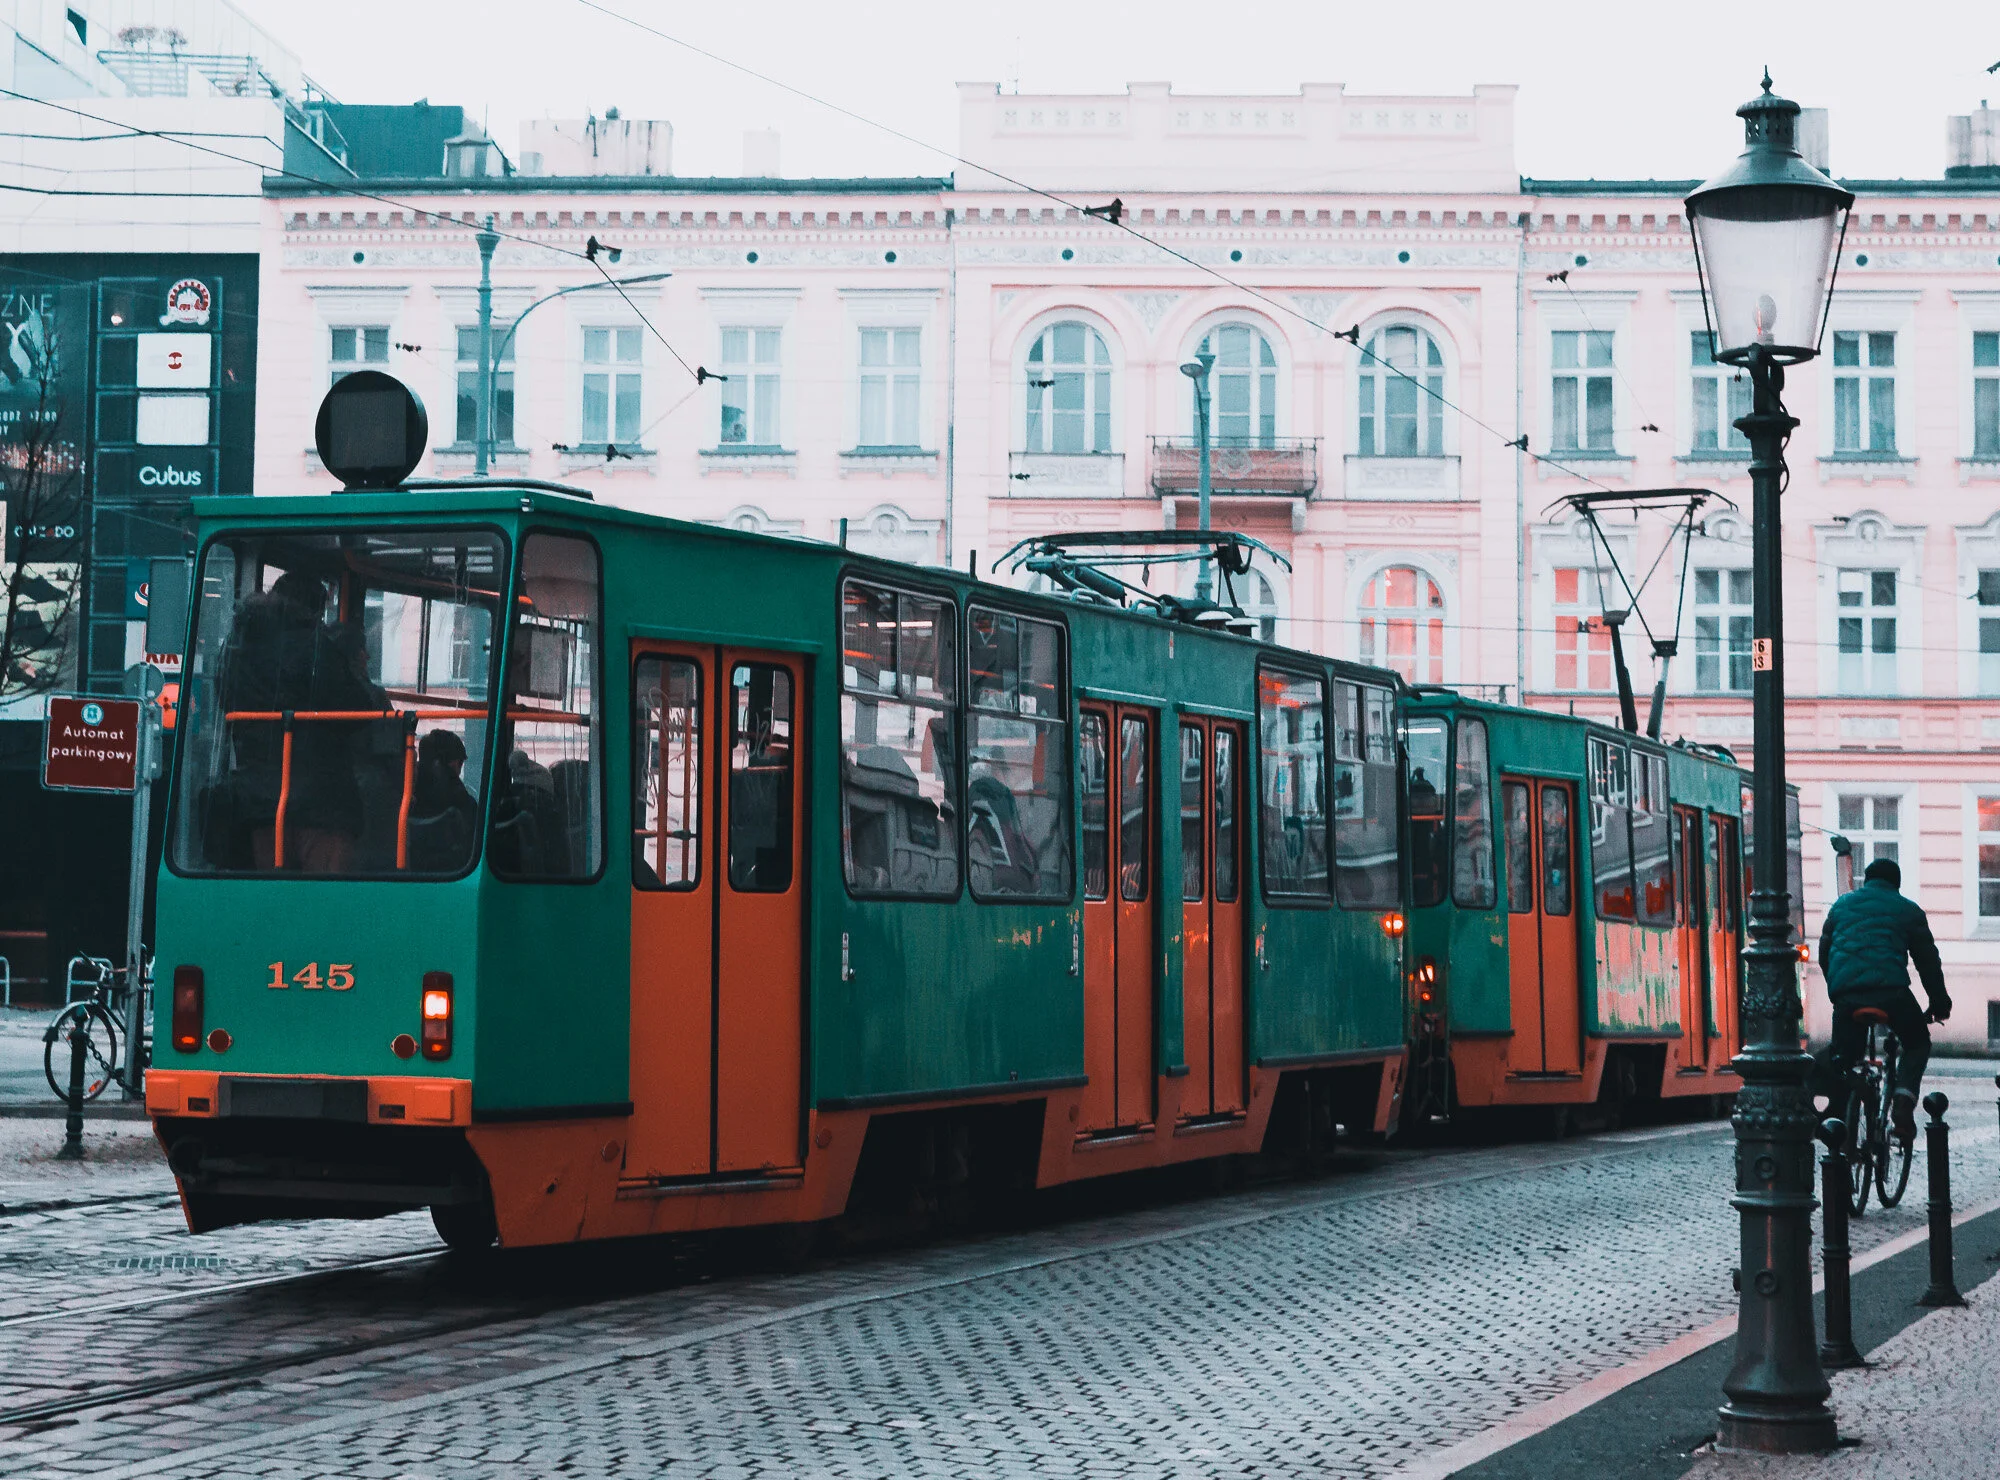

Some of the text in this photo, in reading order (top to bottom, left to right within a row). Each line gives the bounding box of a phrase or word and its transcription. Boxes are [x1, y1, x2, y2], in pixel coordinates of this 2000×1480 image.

[139, 465, 202, 485] Cubus
[64, 725, 124, 739] Automat
[51, 746, 132, 763] parkingowy
[267, 962, 355, 990] 145
